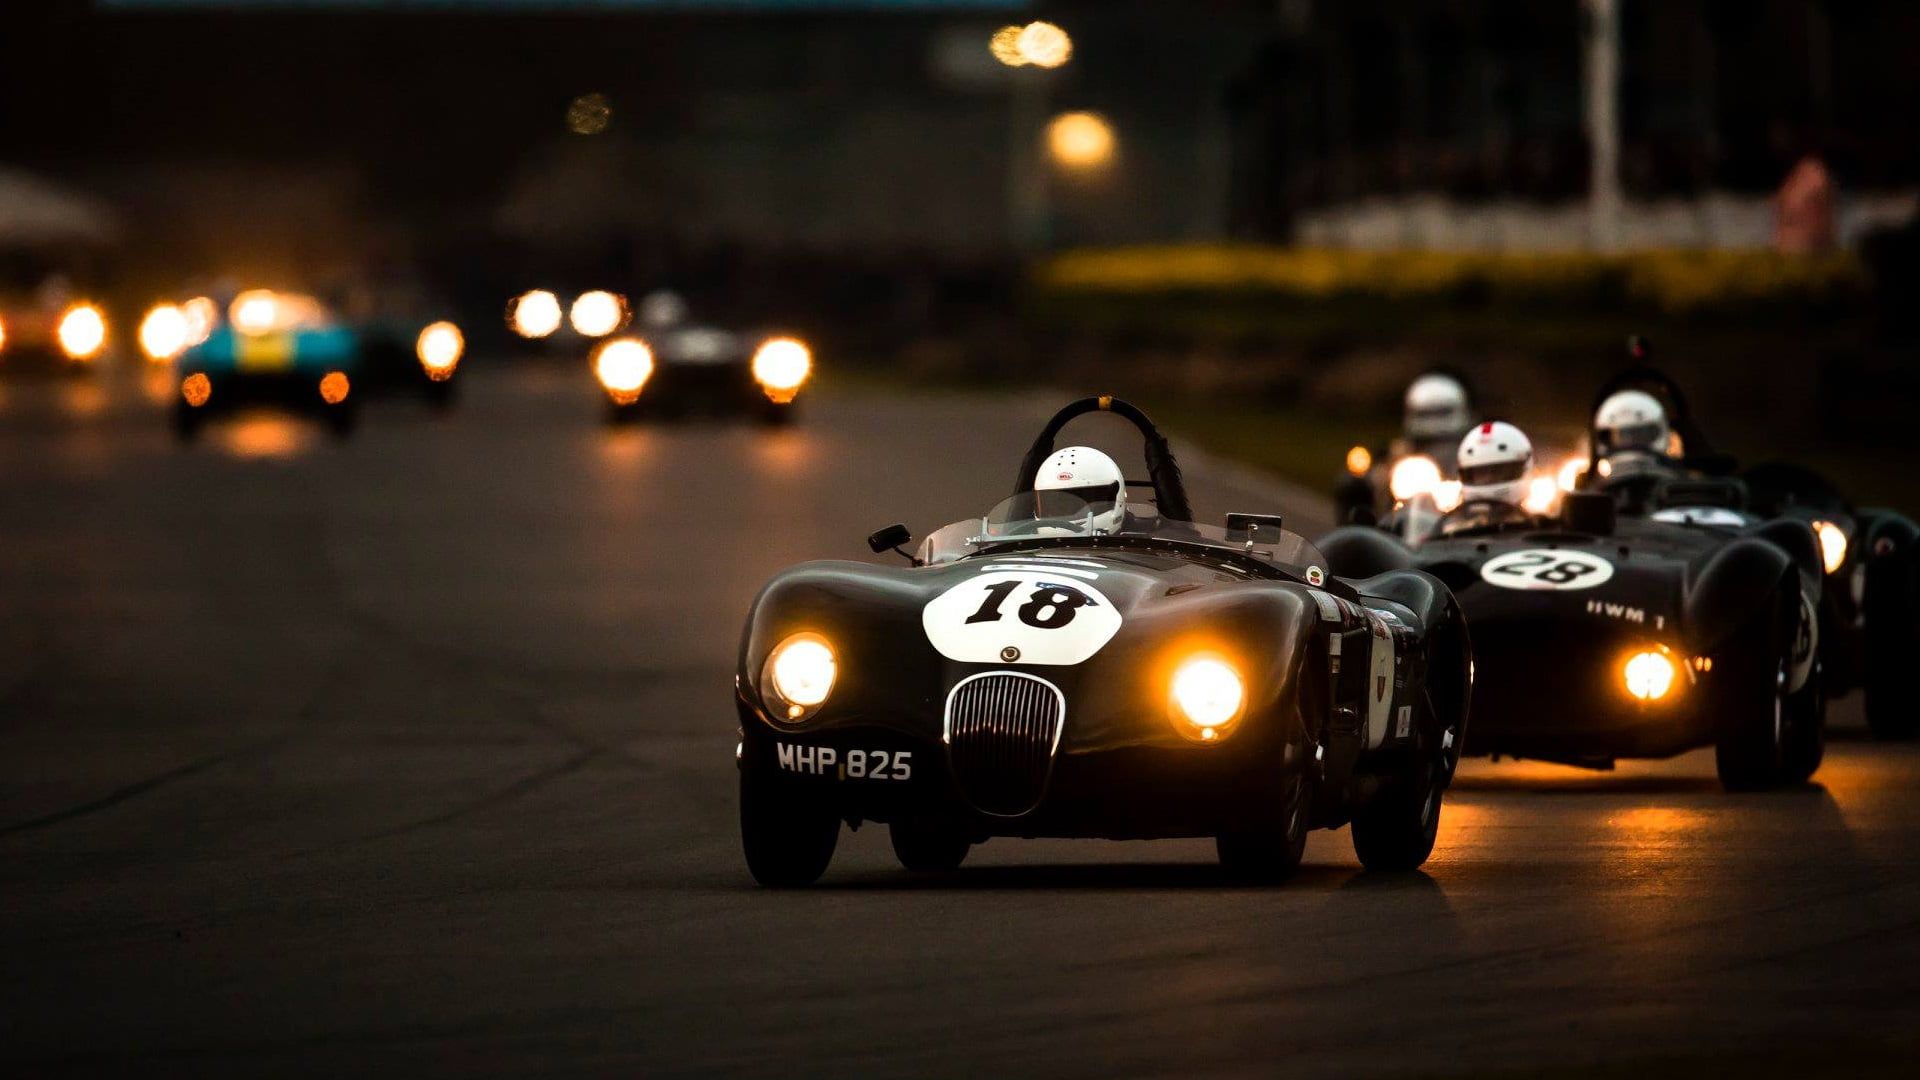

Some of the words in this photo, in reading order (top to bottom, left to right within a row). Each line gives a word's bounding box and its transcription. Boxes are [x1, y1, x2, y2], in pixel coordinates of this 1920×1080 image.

[1494, 552, 1597, 584] 28
[965, 580, 1087, 629] 18
[1585, 598, 1645, 624] HWM
[776, 741, 837, 775] MHP
[846, 749, 913, 781] 825
